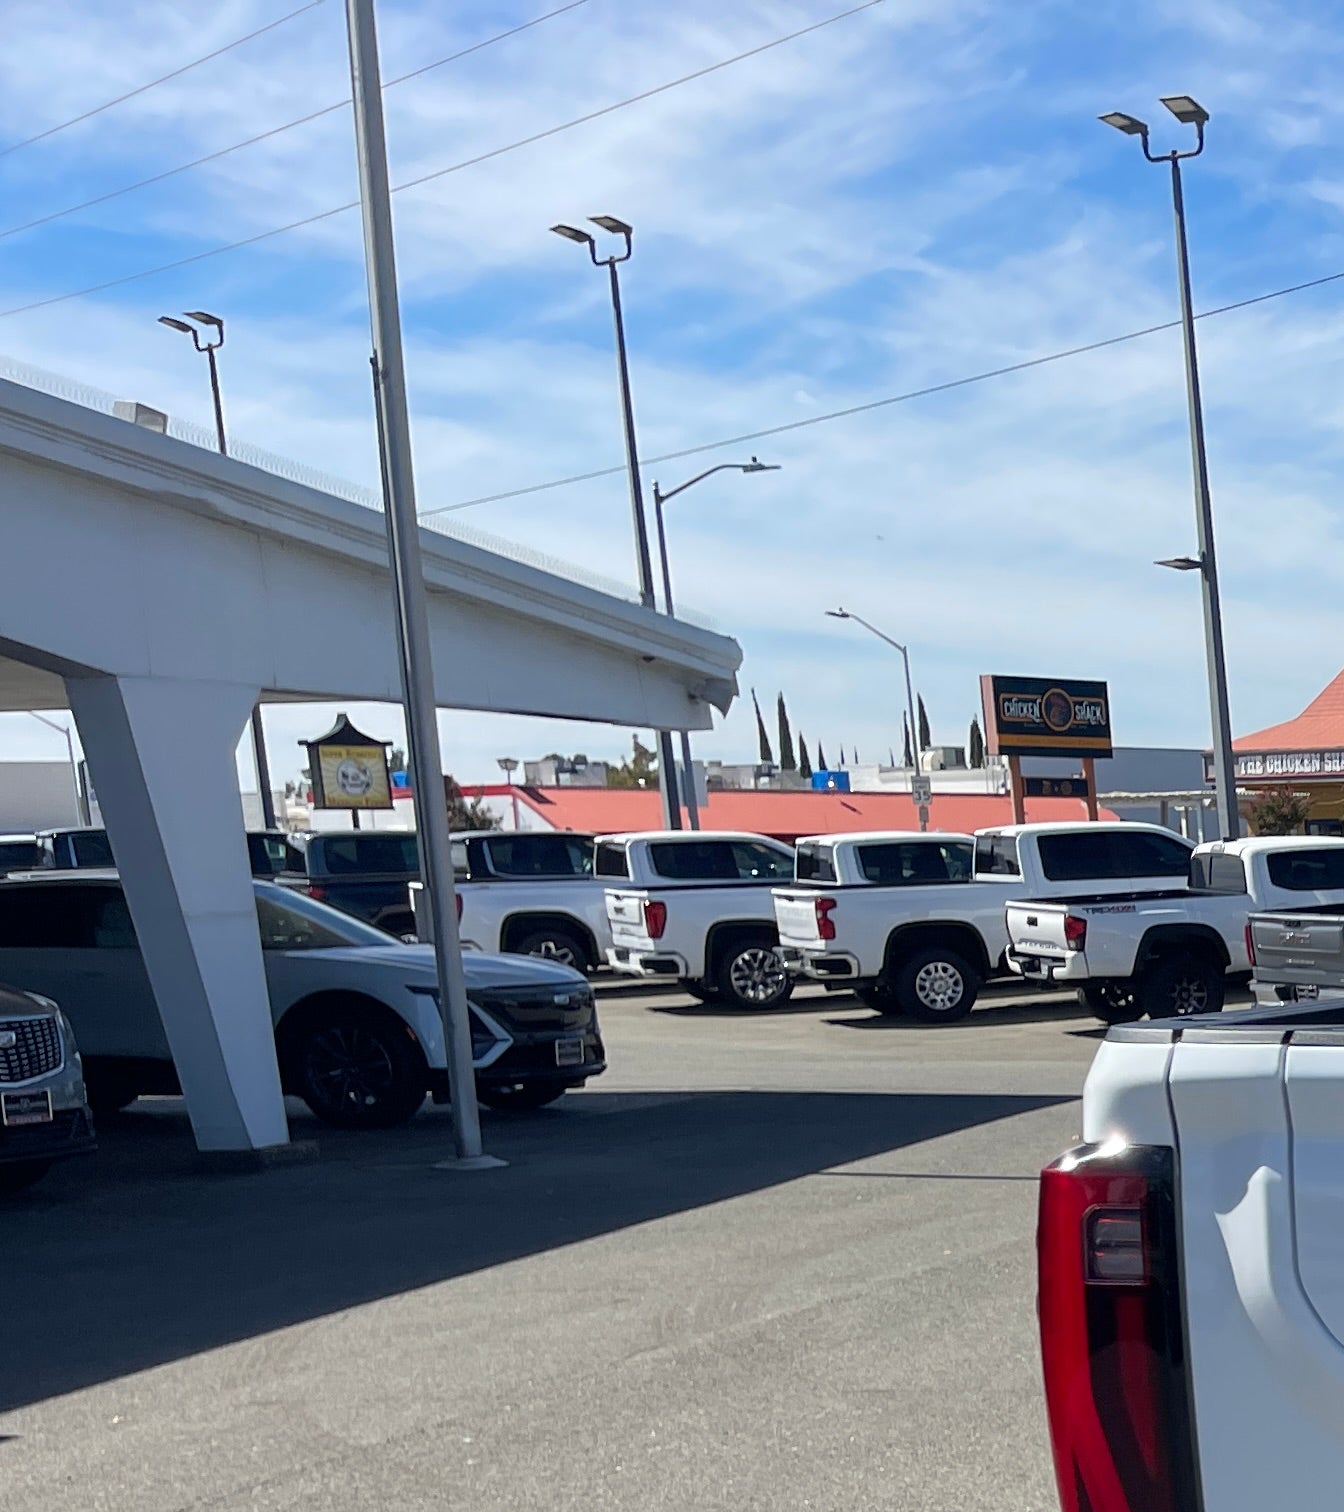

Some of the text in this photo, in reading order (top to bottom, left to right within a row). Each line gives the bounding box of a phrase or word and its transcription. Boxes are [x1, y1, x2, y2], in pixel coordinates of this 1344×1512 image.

[1004, 697, 1106, 725] CHICKEN SHACK
[1238, 755, 1263, 775] THE
[1266, 753, 1321, 774] CHICKEN
